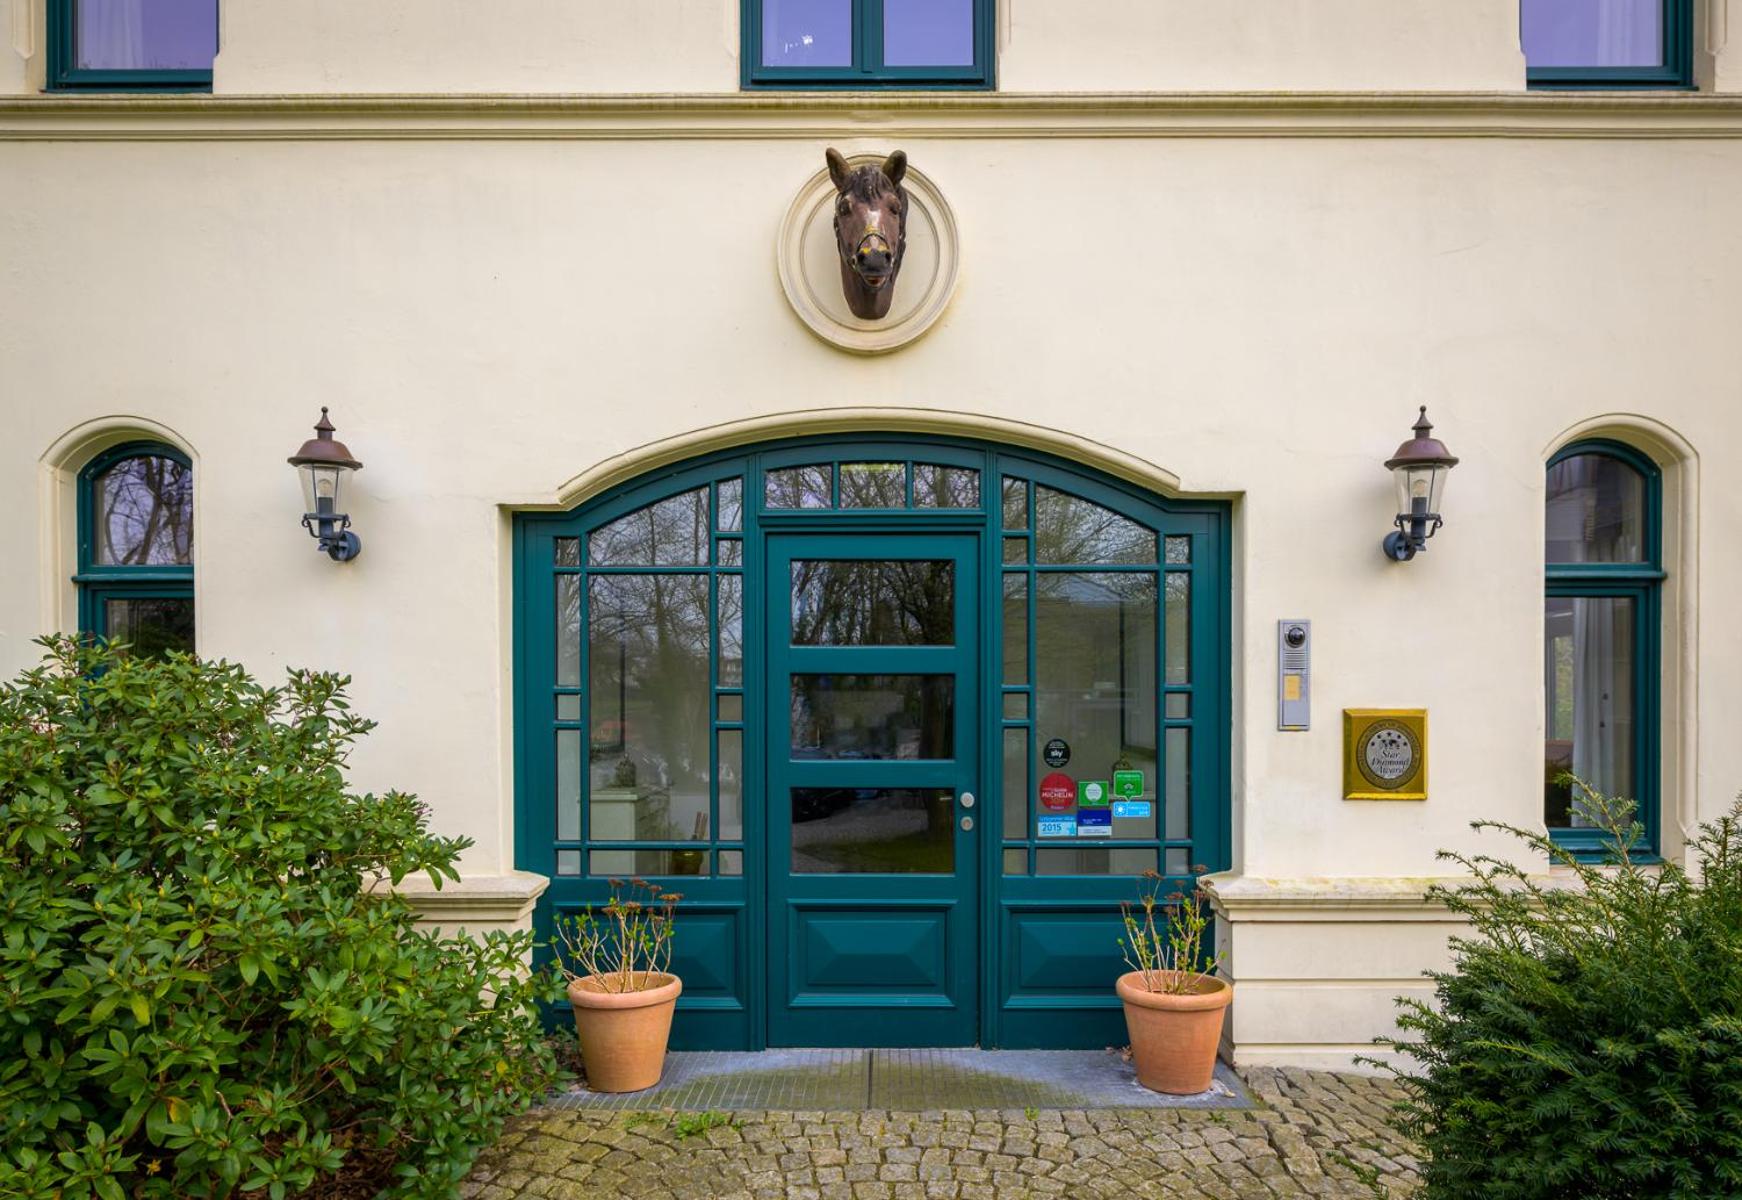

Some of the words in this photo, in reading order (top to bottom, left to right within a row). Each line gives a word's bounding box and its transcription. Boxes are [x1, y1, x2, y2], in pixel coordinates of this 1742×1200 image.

[1051, 749, 1063, 758] sky
[1382, 749, 1400, 758] Star
[1042, 823, 1062, 832] 2015
